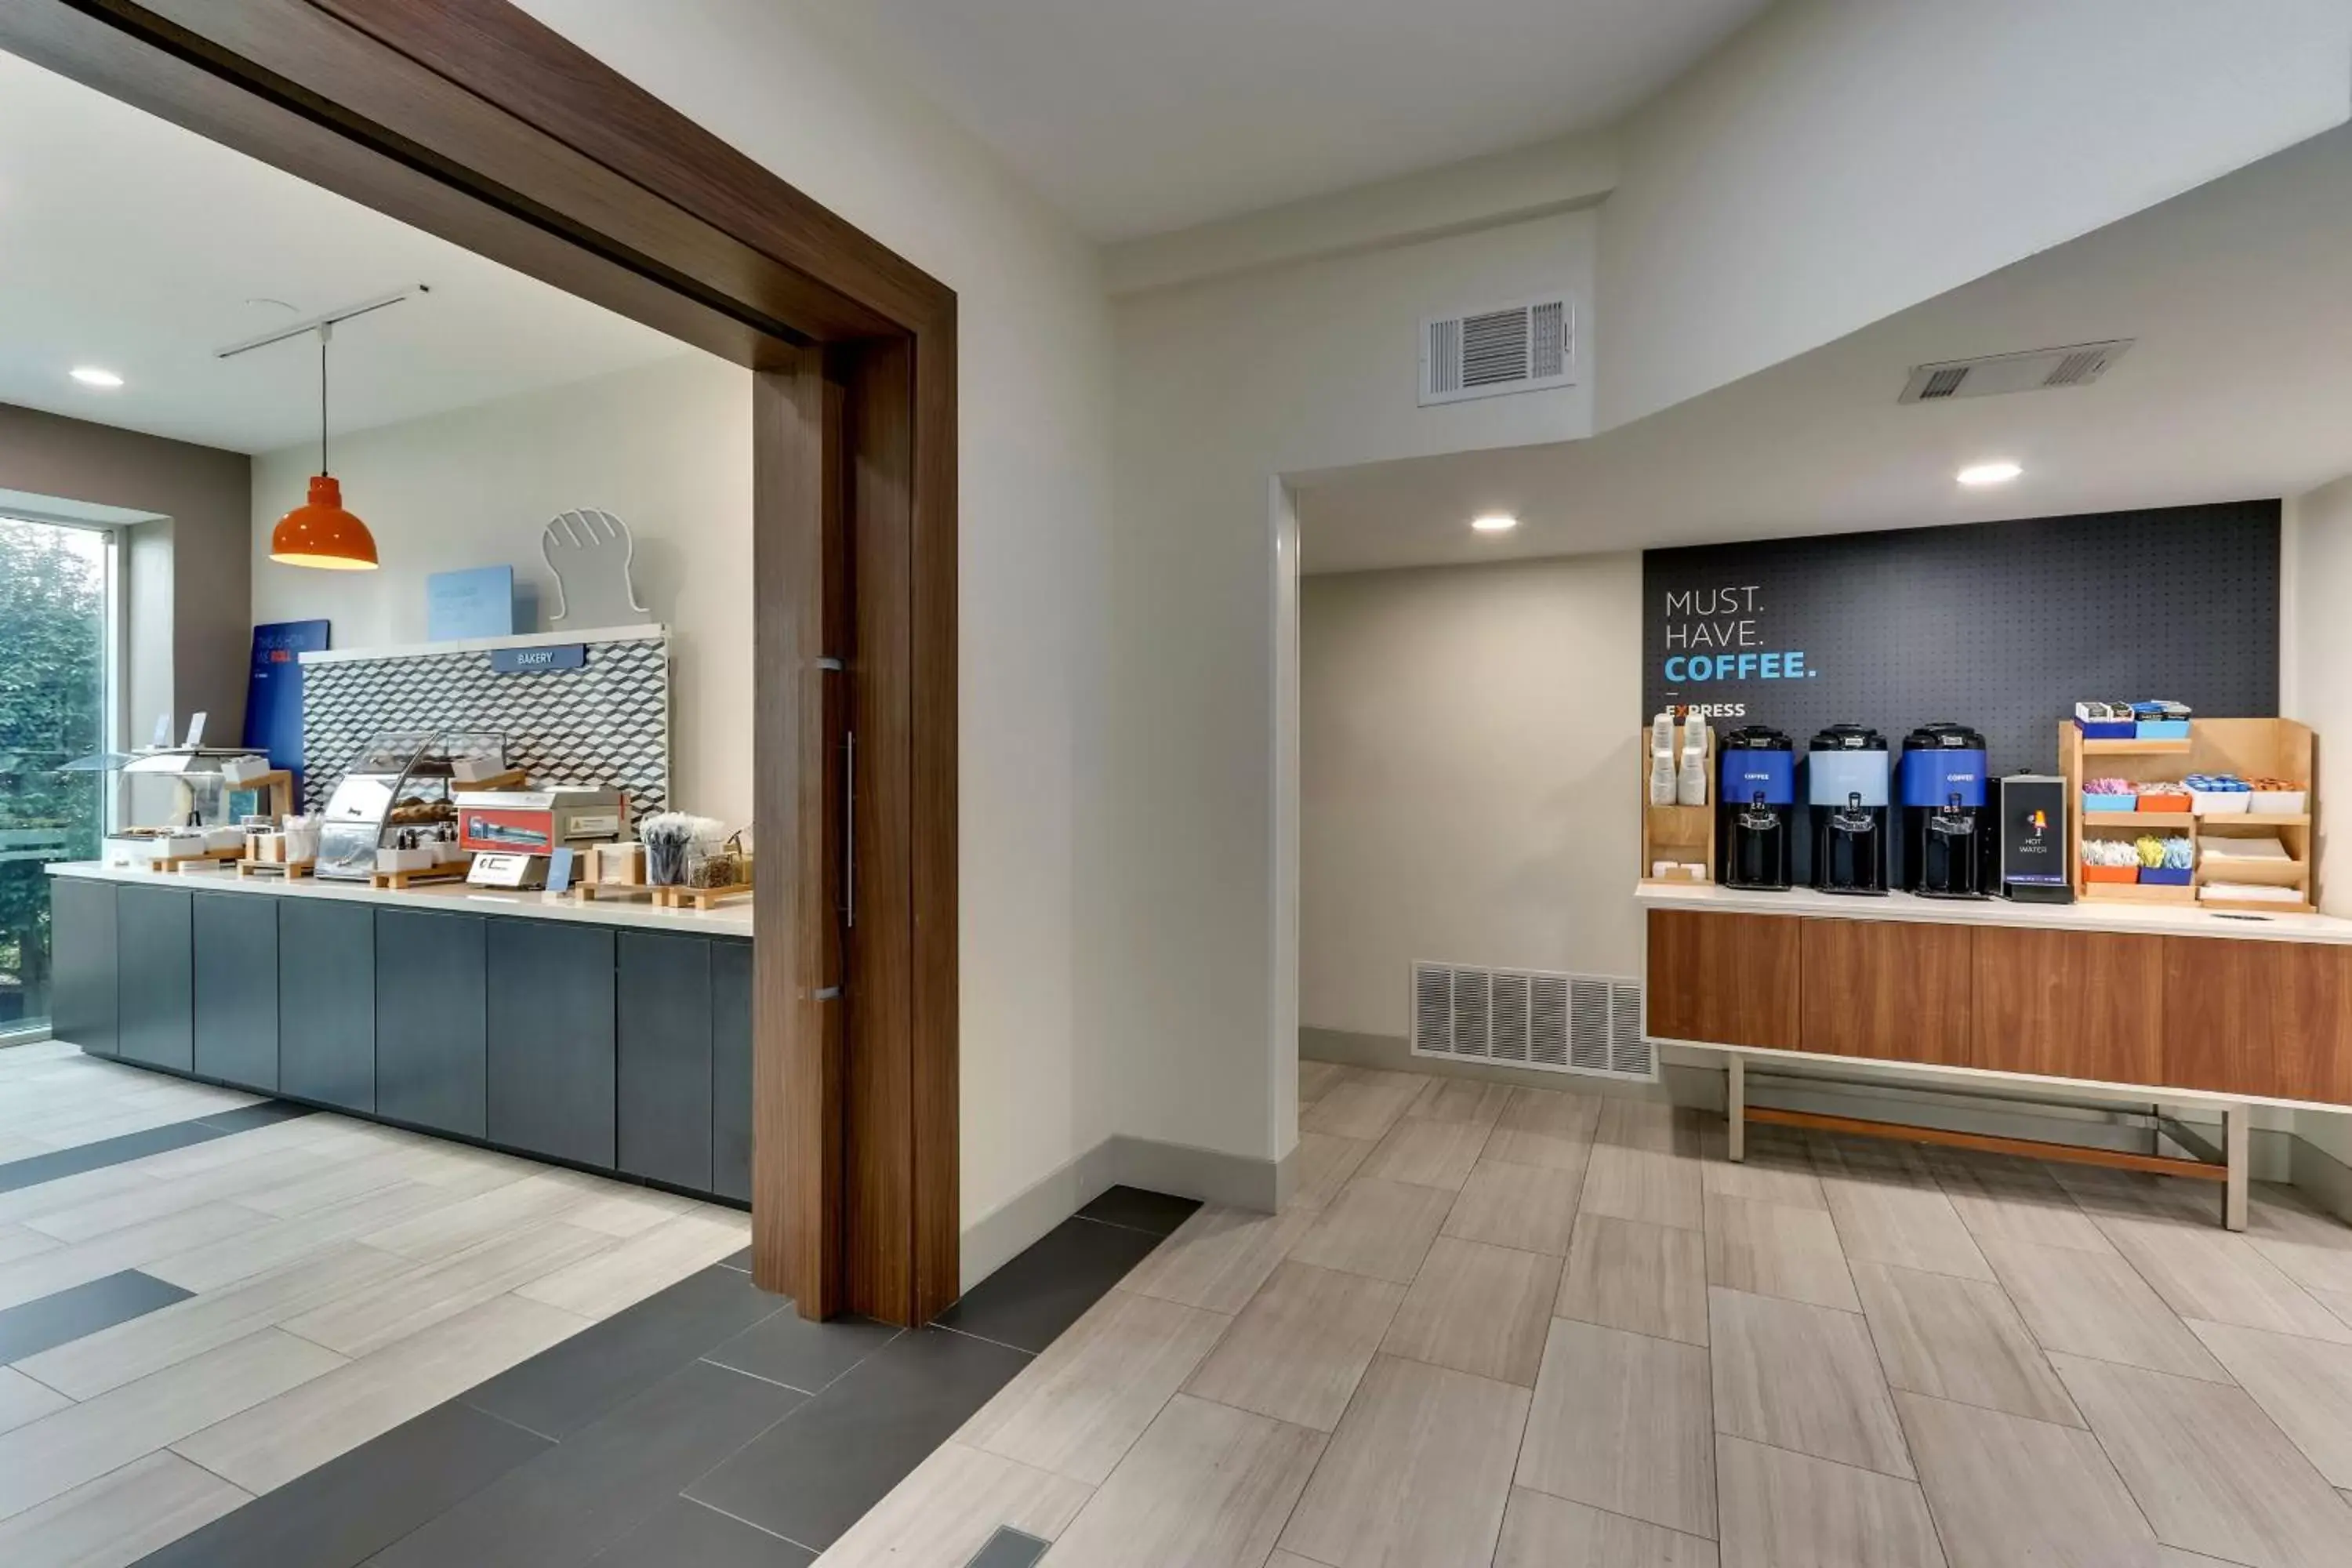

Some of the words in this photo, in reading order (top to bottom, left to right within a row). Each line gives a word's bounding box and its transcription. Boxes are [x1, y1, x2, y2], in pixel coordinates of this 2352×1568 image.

[1666, 586, 1764, 617] MUST.
[1666, 620, 1763, 650] HAVE.
[517, 652, 554, 665] BAKERY
[1664, 652, 1817, 681] COFFEE.
[1666, 703, 1746, 717] EXPRESS
[1947, 773, 1974, 782] COFFEE
